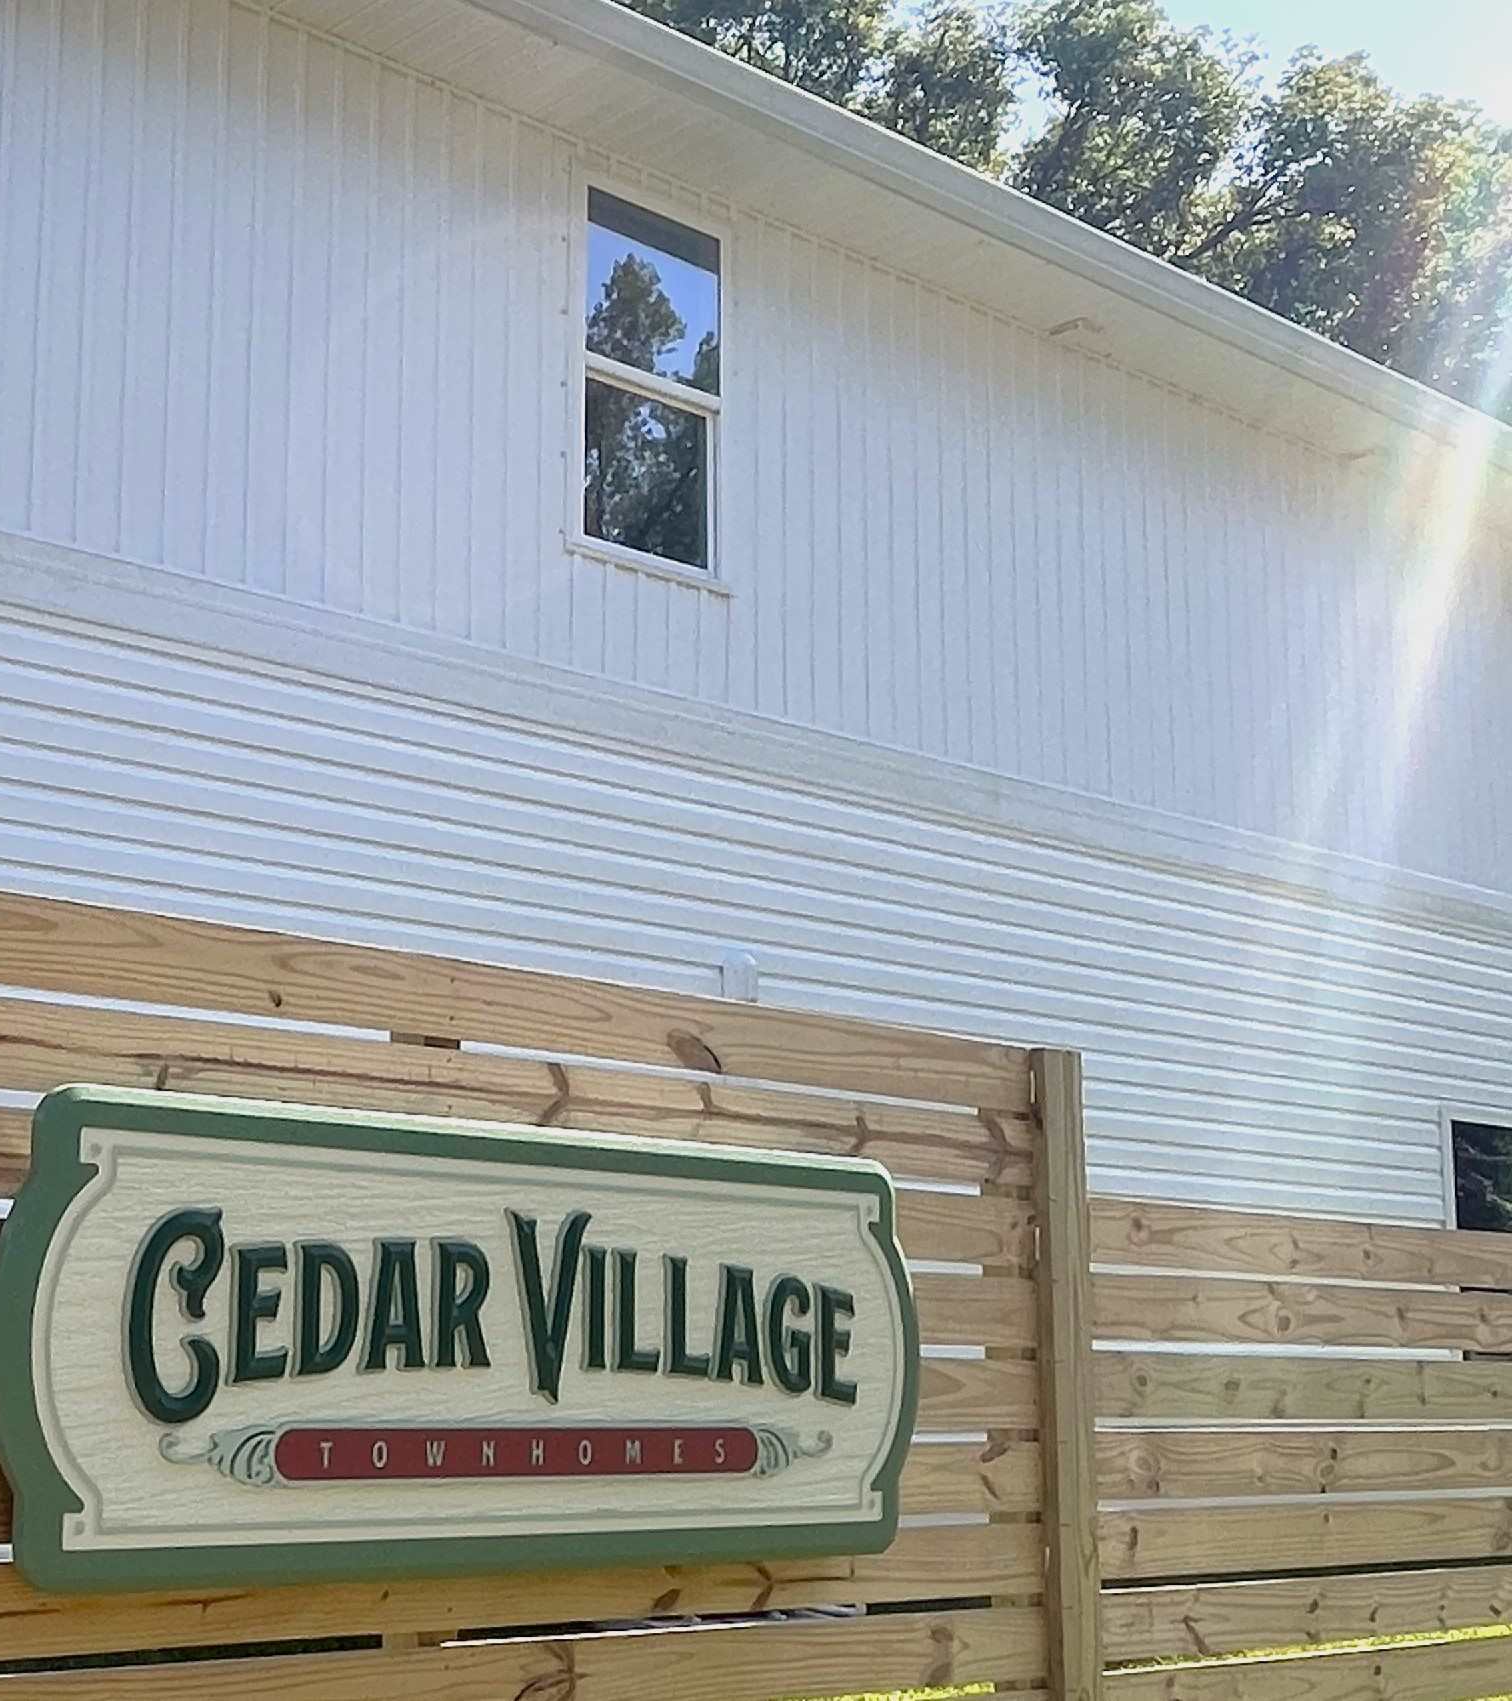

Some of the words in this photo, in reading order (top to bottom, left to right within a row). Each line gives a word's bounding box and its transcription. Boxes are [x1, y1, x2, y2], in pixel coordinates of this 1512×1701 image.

[125, 1205, 491, 1423] CEDAR
[505, 1207, 859, 1404] VILLAGE
[319, 1438, 728, 1469] TOWNHOMES
